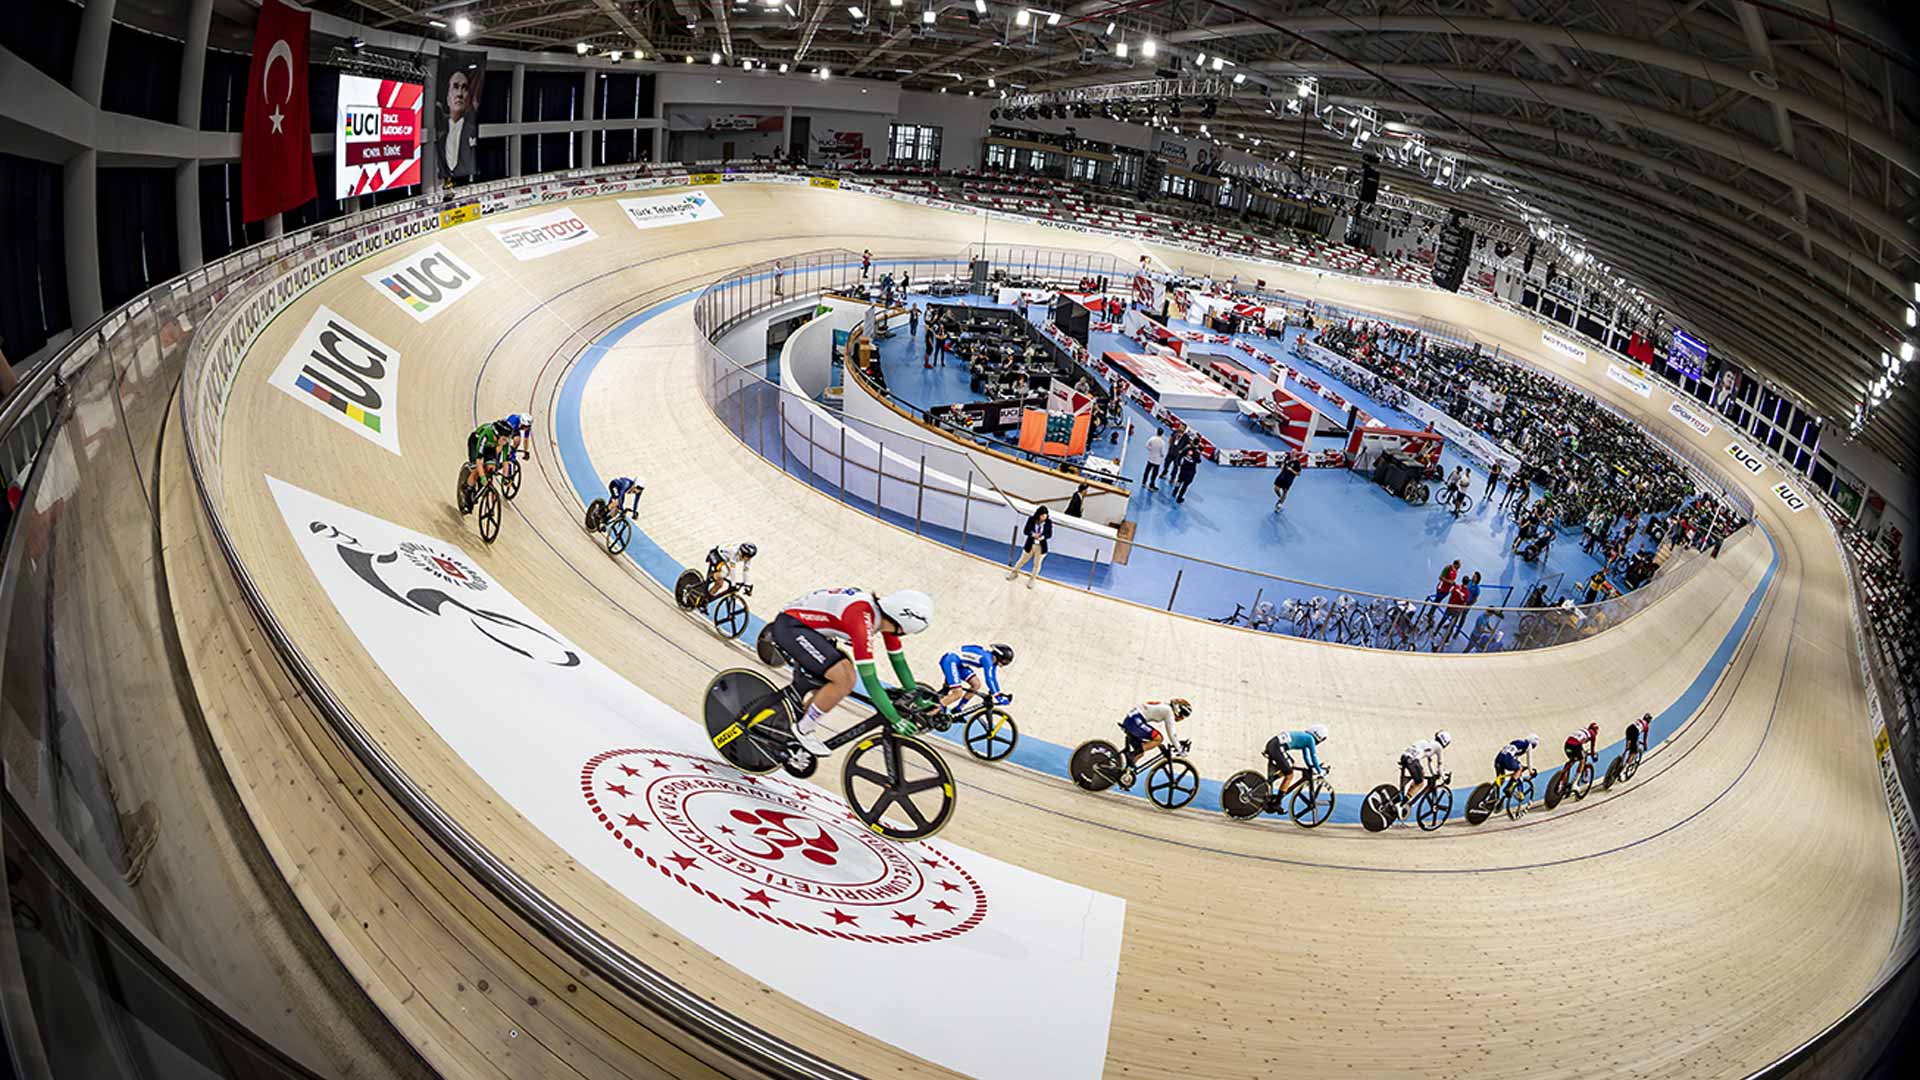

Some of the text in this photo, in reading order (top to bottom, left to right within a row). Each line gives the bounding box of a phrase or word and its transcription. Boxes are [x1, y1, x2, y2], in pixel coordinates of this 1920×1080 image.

[353, 113, 379, 136] UCI
[629, 208, 652, 217] Türk
[653, 202, 694, 214] Telekom
[392, 251, 472, 304] UCI
[302, 320, 388, 410] UCI
[1735, 448, 1763, 472] UCI
[1780, 485, 1804, 510] UCI
[660, 780, 698, 798] SPOR
[658, 795, 677, 811] VE
